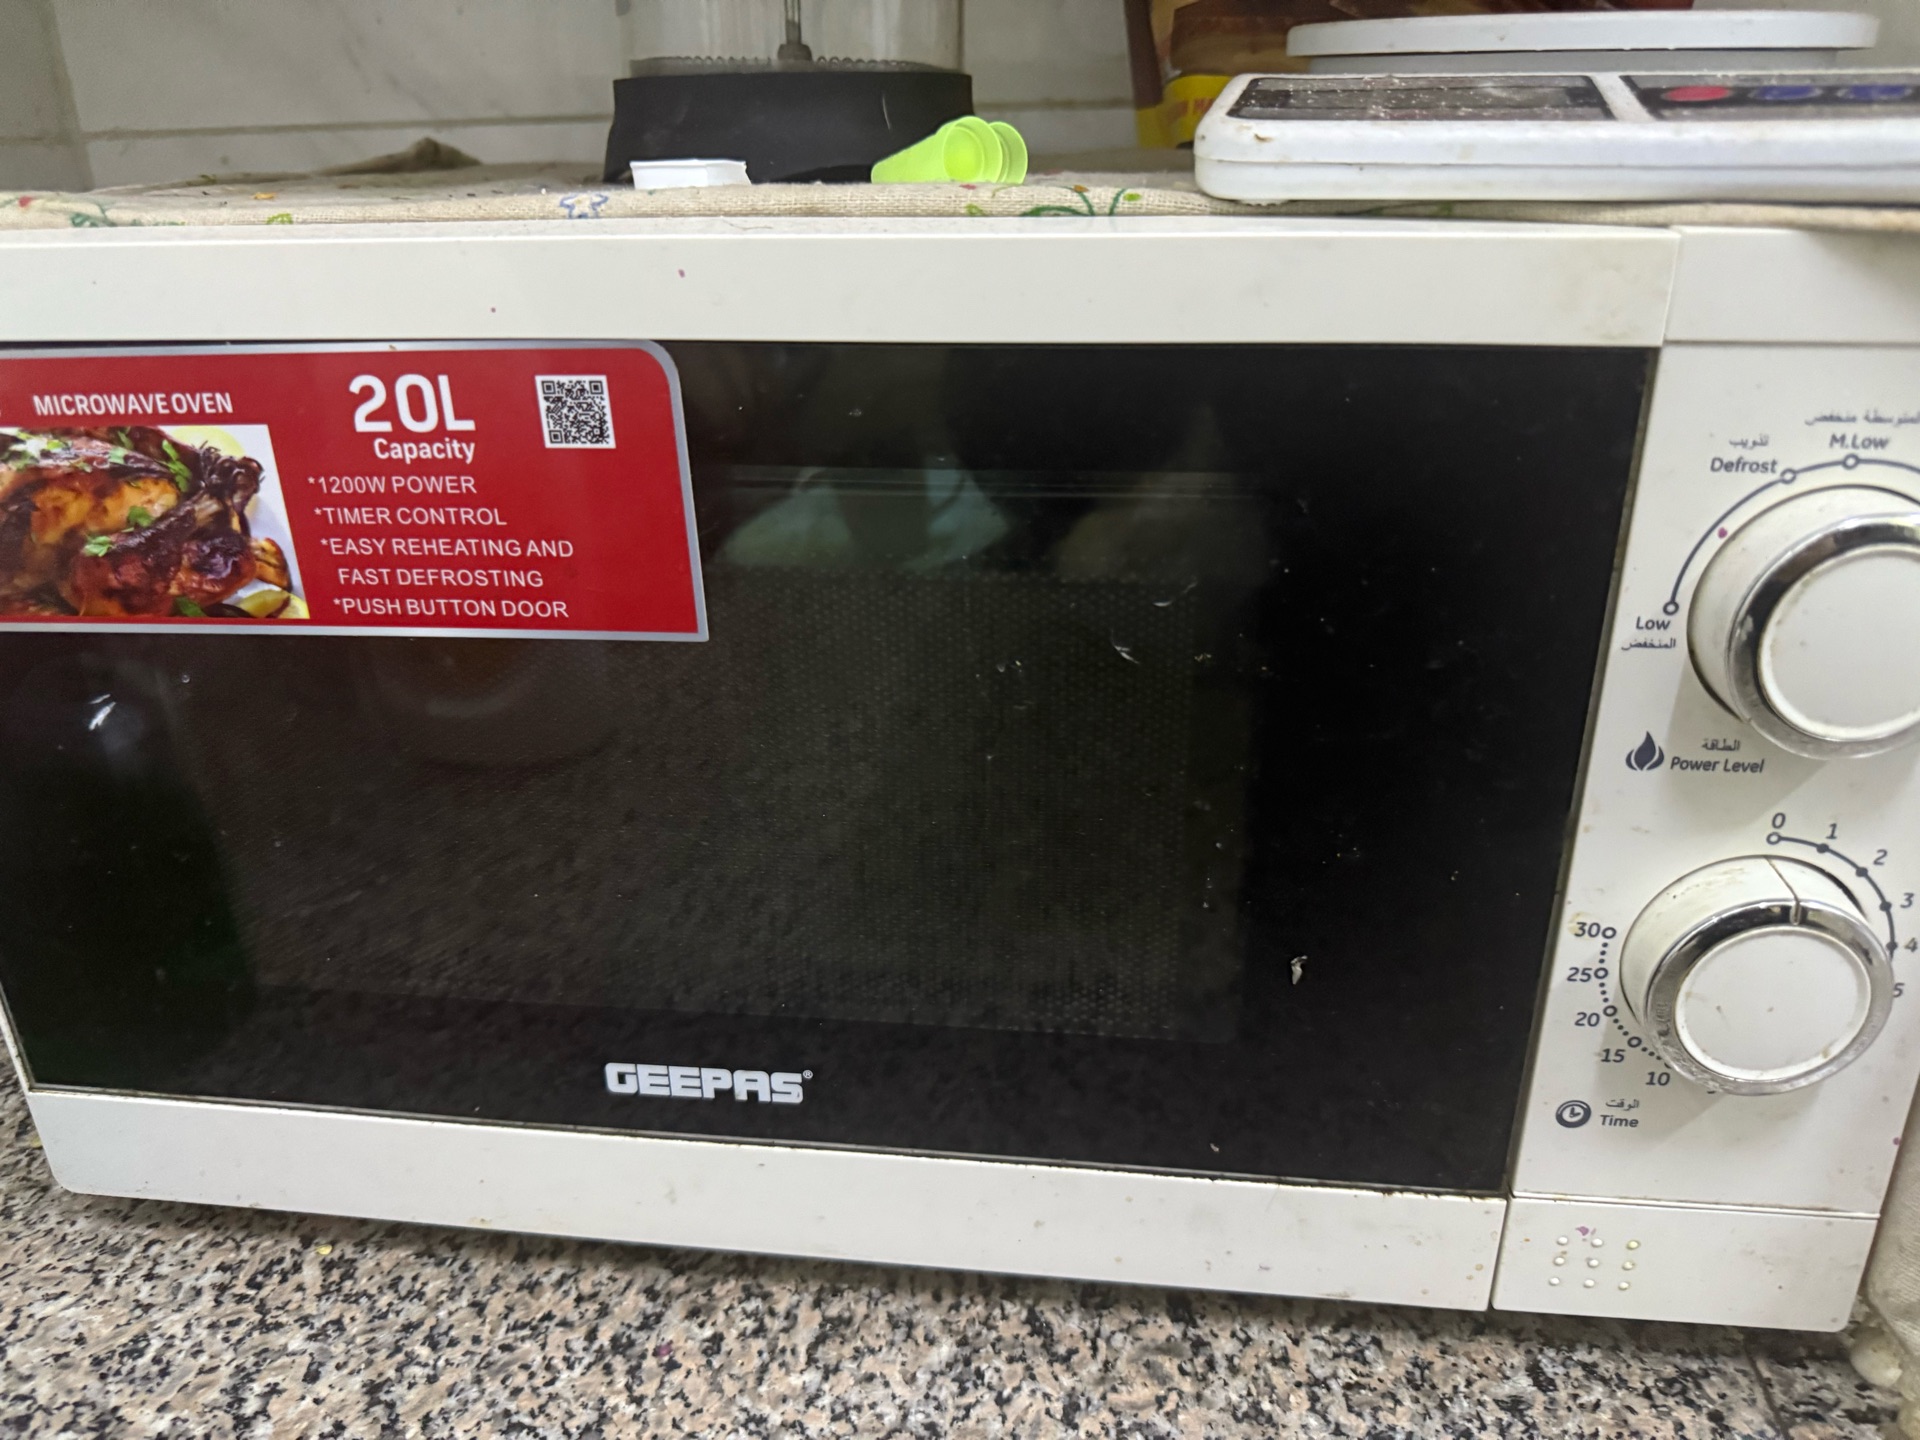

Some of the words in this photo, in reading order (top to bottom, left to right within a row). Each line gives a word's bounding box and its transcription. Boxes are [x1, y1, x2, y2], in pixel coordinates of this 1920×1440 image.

[33, 394, 170, 416] MICROWAVE
[171, 392, 234, 414] OVEN
[348, 373, 477, 433] 20L
[1829, 433, 1890, 450] M.Low
[373, 436, 476, 465] Capacity
[1710, 456, 1778, 474] Defrost
[391, 475, 478, 494] POWER
[396, 507, 508, 526] CONTROL
[391, 538, 523, 557] REHEATING
[525, 539, 574, 558] AND
[337, 567, 391, 586] FAST
[396, 568, 544, 588] DEFROSTING
[406, 598, 497, 617] BUTTON
[501, 600, 570, 618] DOOR
[1635, 616, 1671, 631] Low
[1669, 756, 1720, 772] Power
[1723, 758, 1765, 773] Level
[1771, 812, 1787, 829] 0
[1825, 823, 1839, 840] 1
[1872, 849, 1889, 866] 2
[1899, 892, 1915, 909] 3
[1573, 922, 1600, 938] 30
[1903, 937, 1918, 953] 4
[1566, 967, 1592, 983] 25
[1892, 982, 1905, 998] 5
[1573, 1012, 1600, 1028] 20
[1600, 1049, 1626, 1063] 15
[1645, 1072, 1671, 1087] 10
[1599, 1114, 1639, 1128] Time
